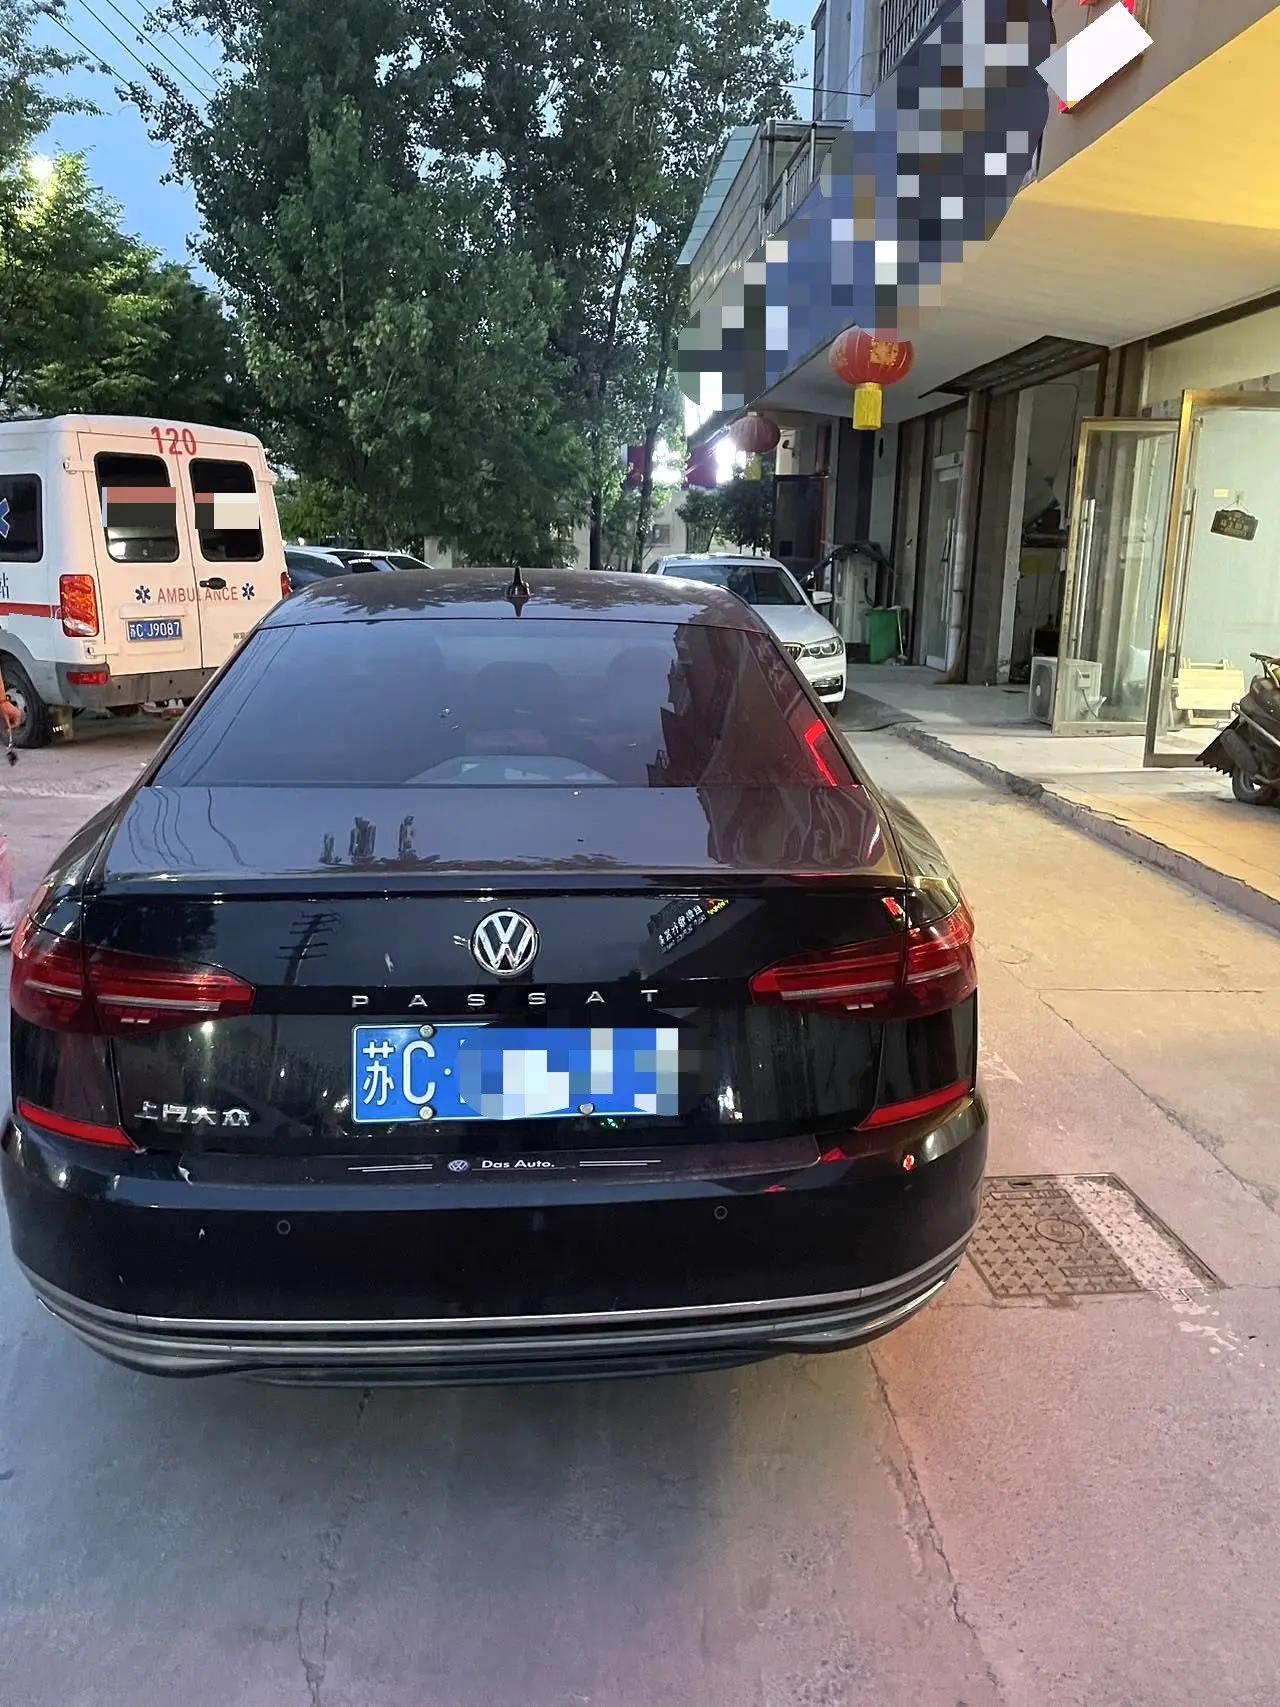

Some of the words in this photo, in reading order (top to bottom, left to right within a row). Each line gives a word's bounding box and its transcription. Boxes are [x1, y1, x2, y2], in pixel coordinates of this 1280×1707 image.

[151, 426, 197, 455] 120
[157, 587, 239, 603] AMBULANCE
[351, 989, 659, 1008] PASSAT
[481, 1160, 510, 1169] Das
